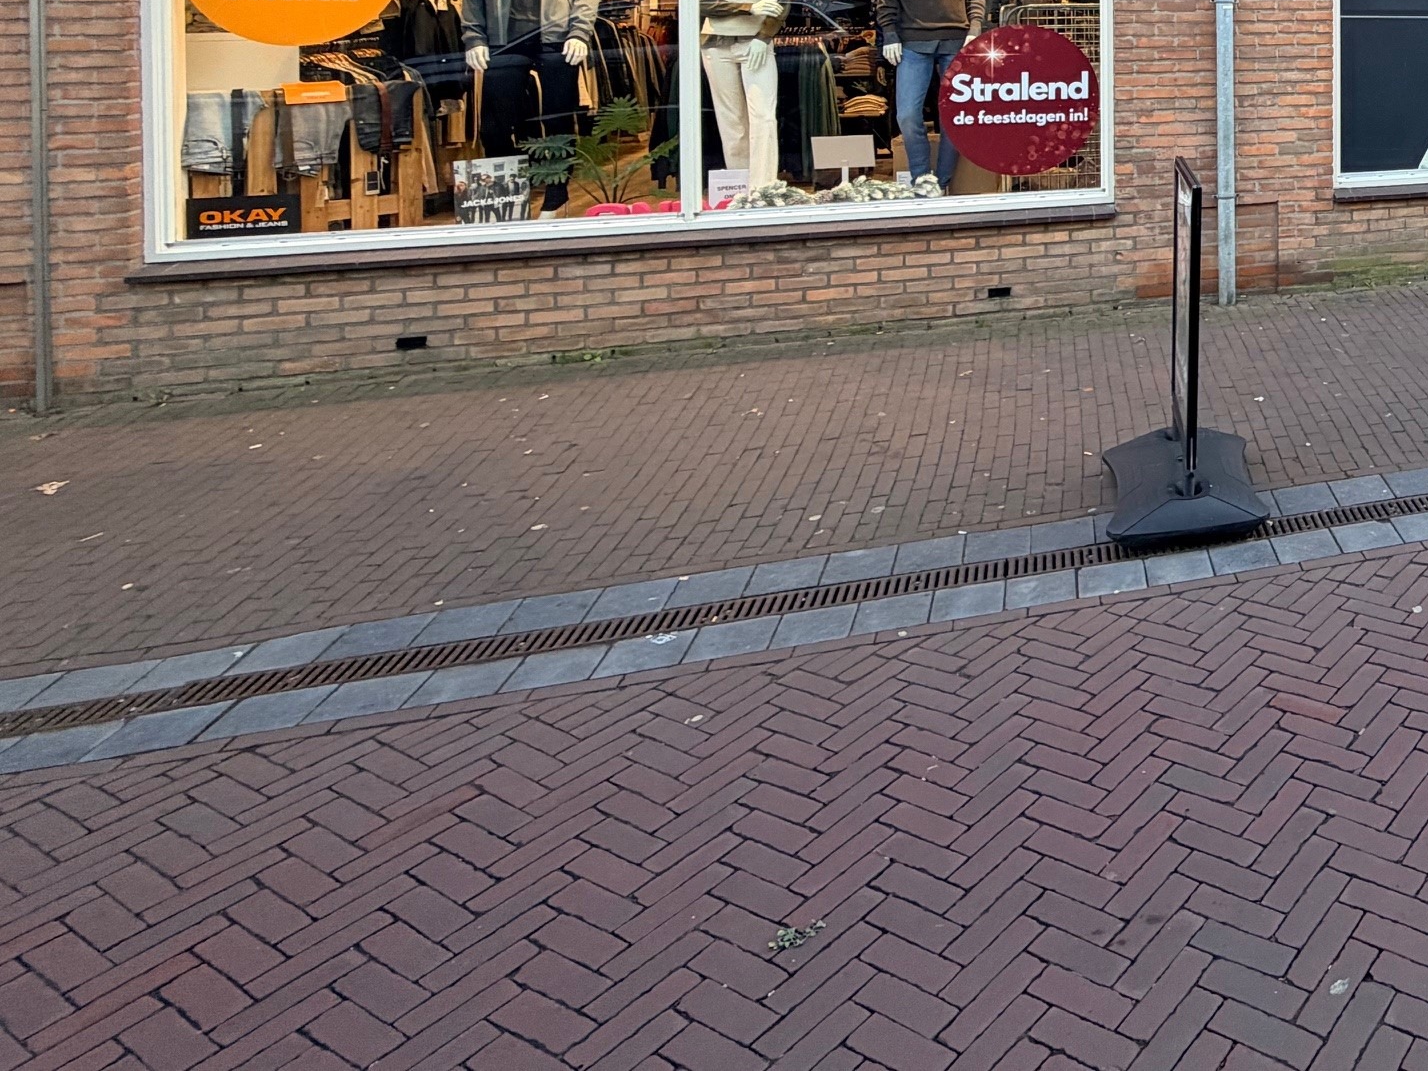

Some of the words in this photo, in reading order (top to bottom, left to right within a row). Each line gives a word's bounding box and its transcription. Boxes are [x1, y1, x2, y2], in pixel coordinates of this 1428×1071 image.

[949, 70, 1089, 103] Stralend
[953, 110, 975, 125] de
[978, 109, 1066, 127] feestdagen
[1069, 107, 1089, 122] in!
[460, 194, 526, 208] JACK&JONES
[199, 207, 288, 224] OKAY
[199, 222, 244, 231] FASHION
[256, 220, 288, 228] JEANS
